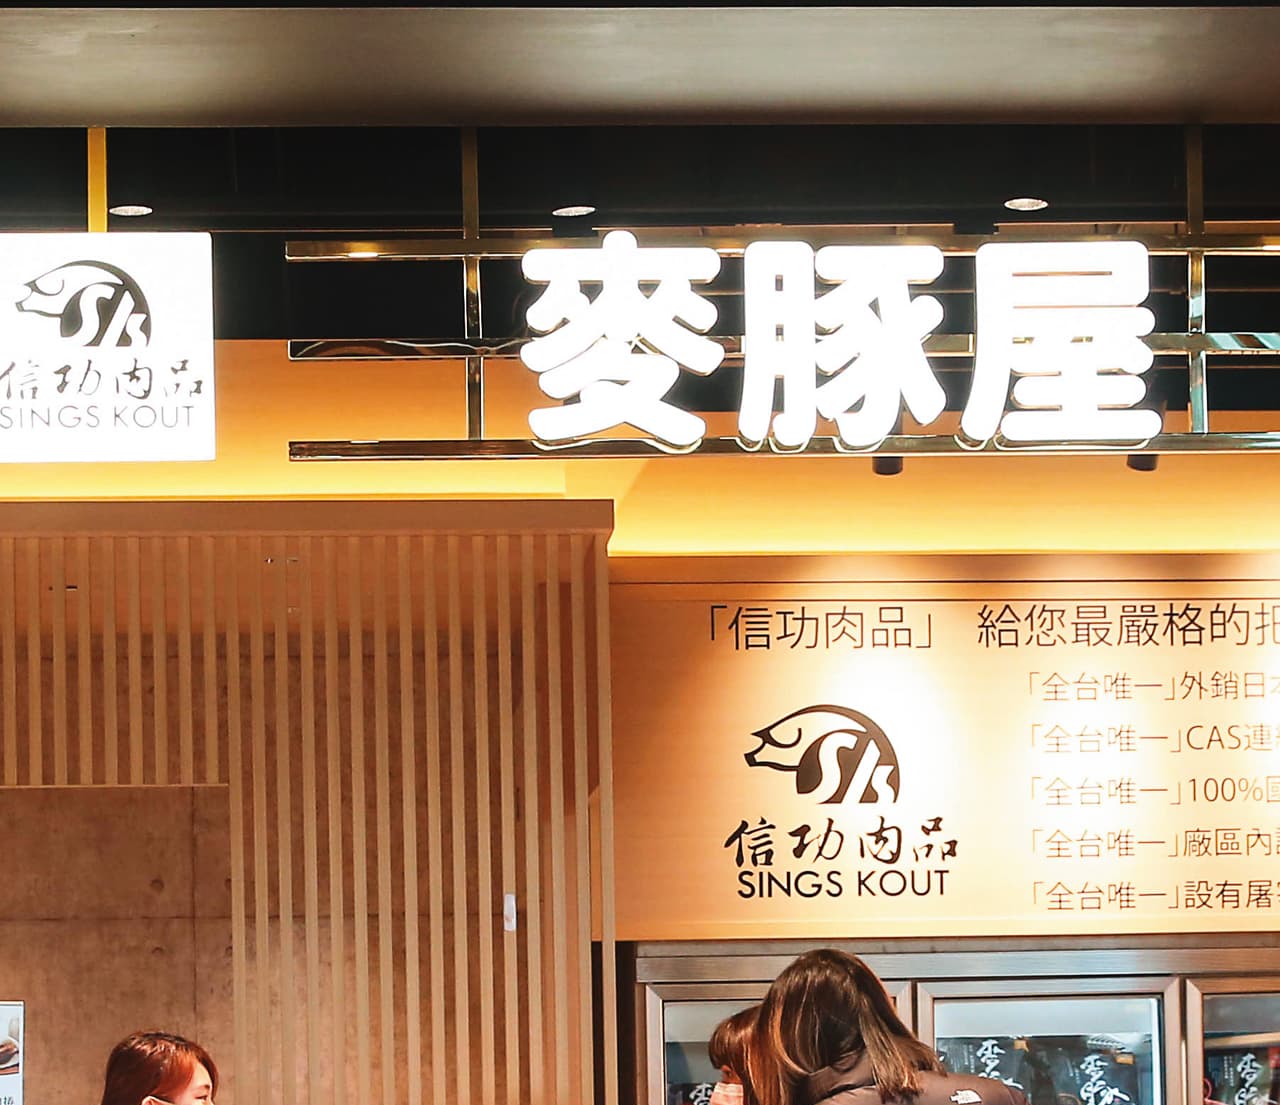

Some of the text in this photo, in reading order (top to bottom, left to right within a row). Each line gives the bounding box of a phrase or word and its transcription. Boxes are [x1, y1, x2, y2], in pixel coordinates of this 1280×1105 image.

[519, 229, 1162, 453] 麥豚屋
[0, 404, 195, 429] SINGS KOUT
[708, 603, 933, 651] 「信功肉品」
[723, 816, 958, 867] 信功肉品
[738, 869, 950, 898] SINGS KOUT
